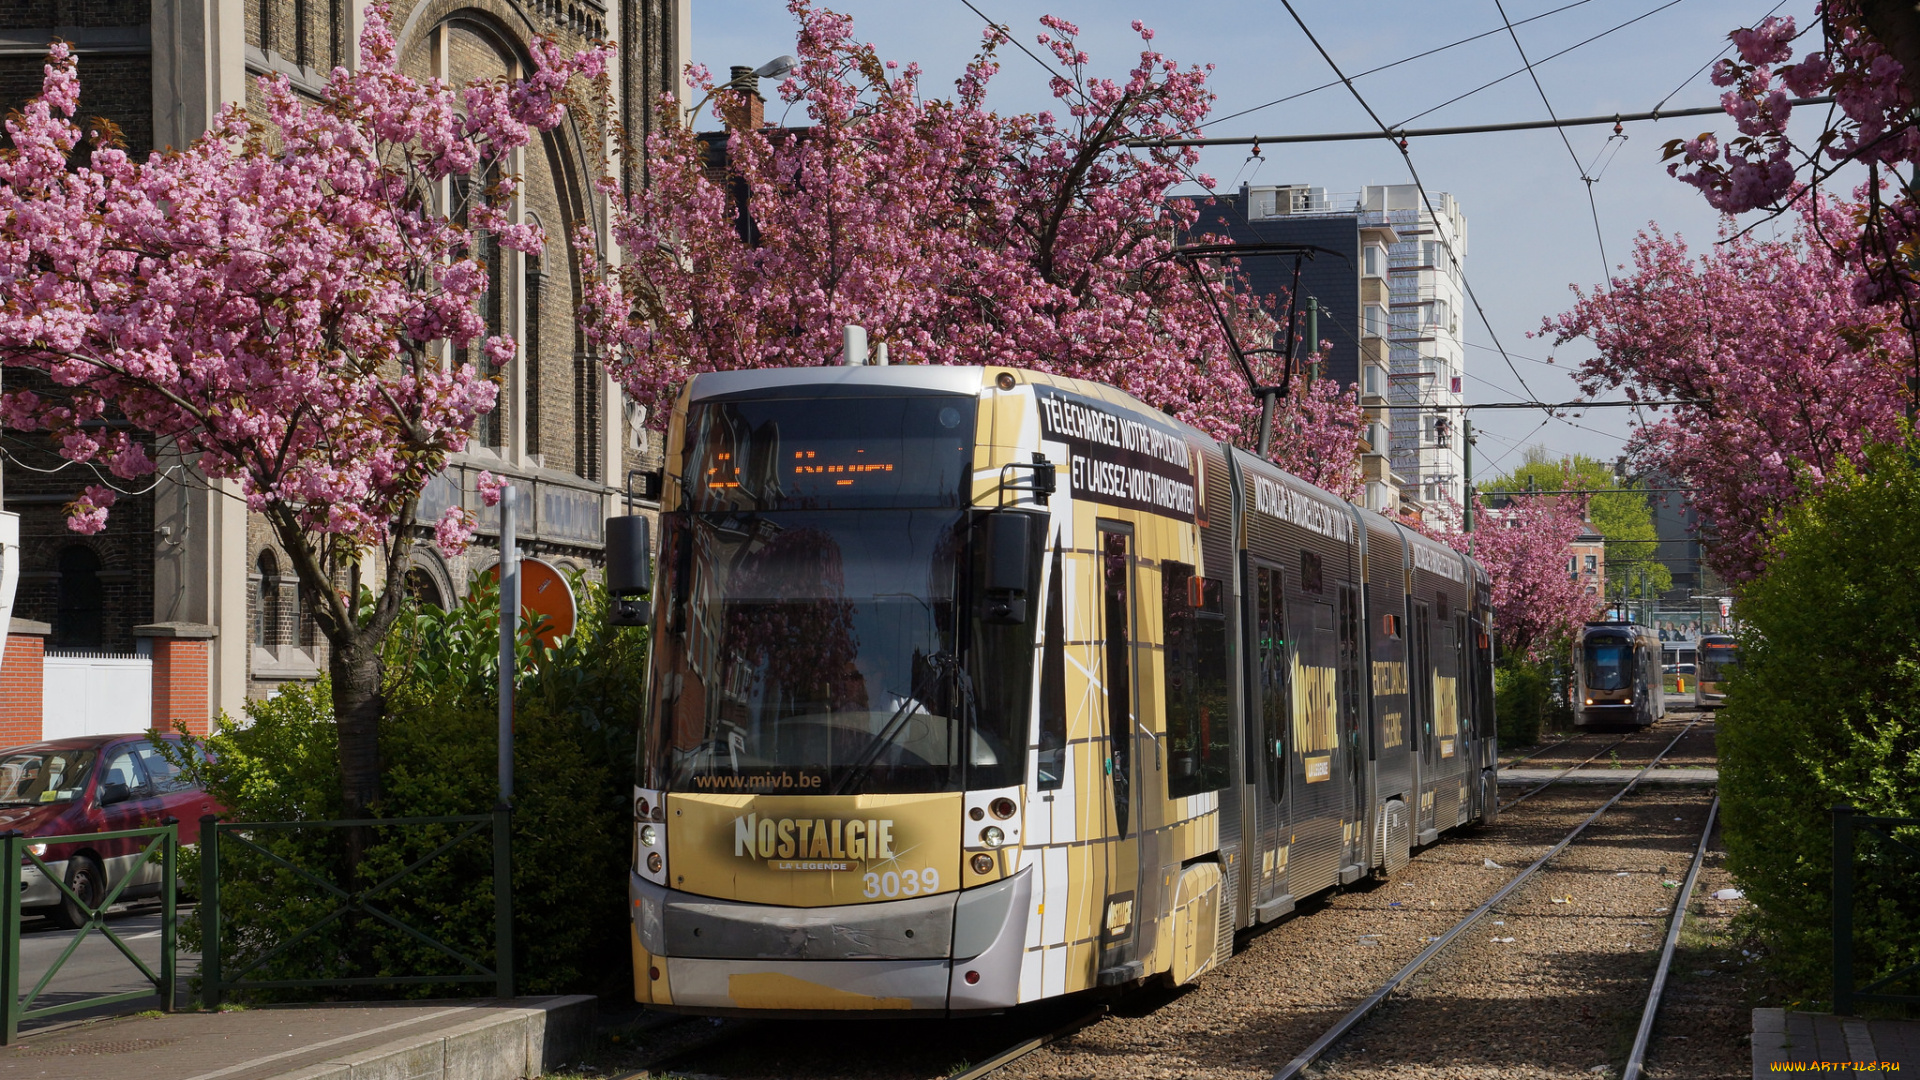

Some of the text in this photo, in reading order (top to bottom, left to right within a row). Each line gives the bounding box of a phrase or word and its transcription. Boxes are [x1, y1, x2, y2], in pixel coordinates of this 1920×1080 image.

[1041, 392, 1190, 470] TÉLÉCHARGEZ NOTRE APPLICATION
[1072, 455, 1195, 515] ET LAISSEZ-VOUS TRANSPORTER
[1291, 651, 1339, 763] NOSTALGIE
[696, 771, 822, 788] www.mivb.be
[734, 812, 894, 862] NOSTALGIE
[779, 862, 793, 870] LA
[863, 867, 939, 899] 3039
